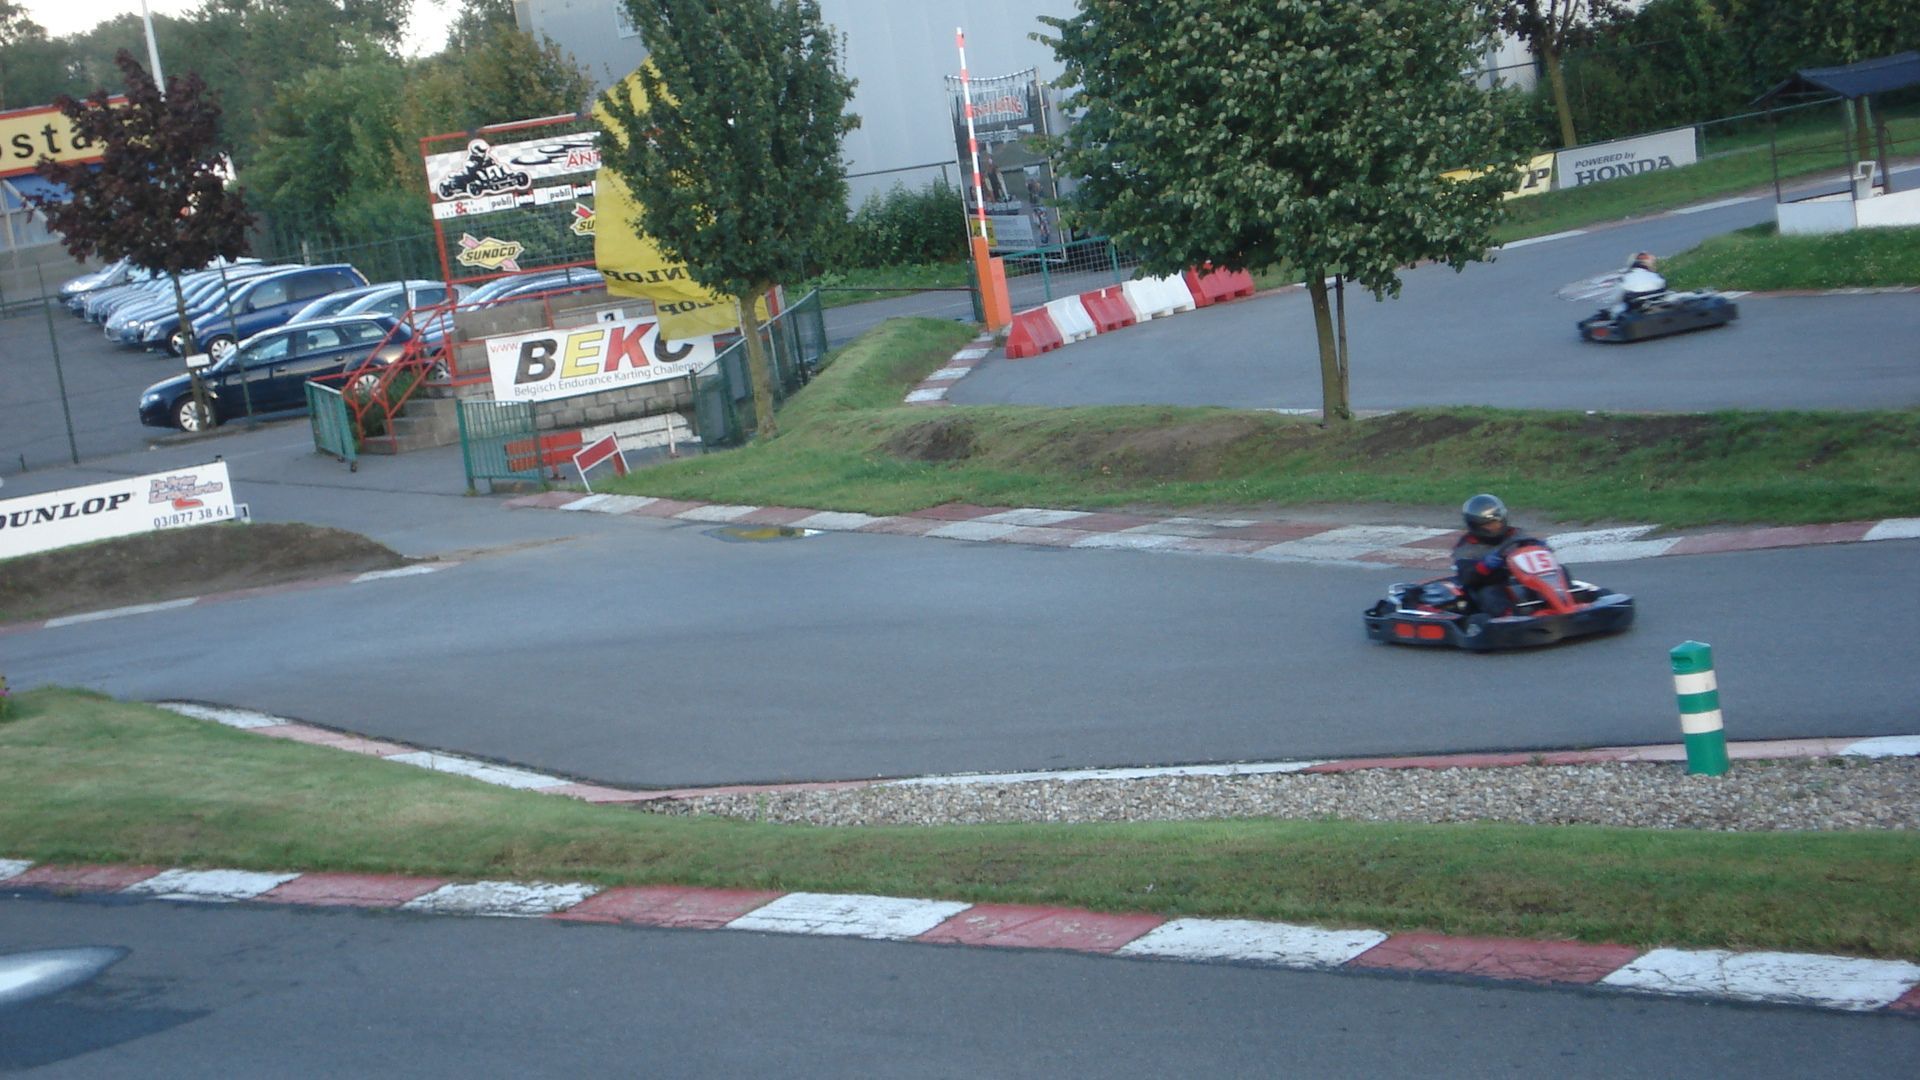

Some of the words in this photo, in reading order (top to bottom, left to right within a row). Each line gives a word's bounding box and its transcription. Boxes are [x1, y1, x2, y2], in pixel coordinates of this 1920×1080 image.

[1575, 153, 1622, 169] POWERED
[1624, 152, 1637, 161] by
[1575, 155, 1677, 187] HONDA
[550, 186, 571, 199] publi
[491, 197, 512, 208] publi
[465, 246, 516, 261] SUNOCO
[514, 382, 556, 396] Belgisch
[559, 374, 613, 390] Endurance
[615, 367, 651, 380] Karting
[653, 361, 704, 376] Challenge
[153, 511, 193, 528] 03/877
[198, 508, 213, 520] 38
[1525, 552, 1552, 571] 15
